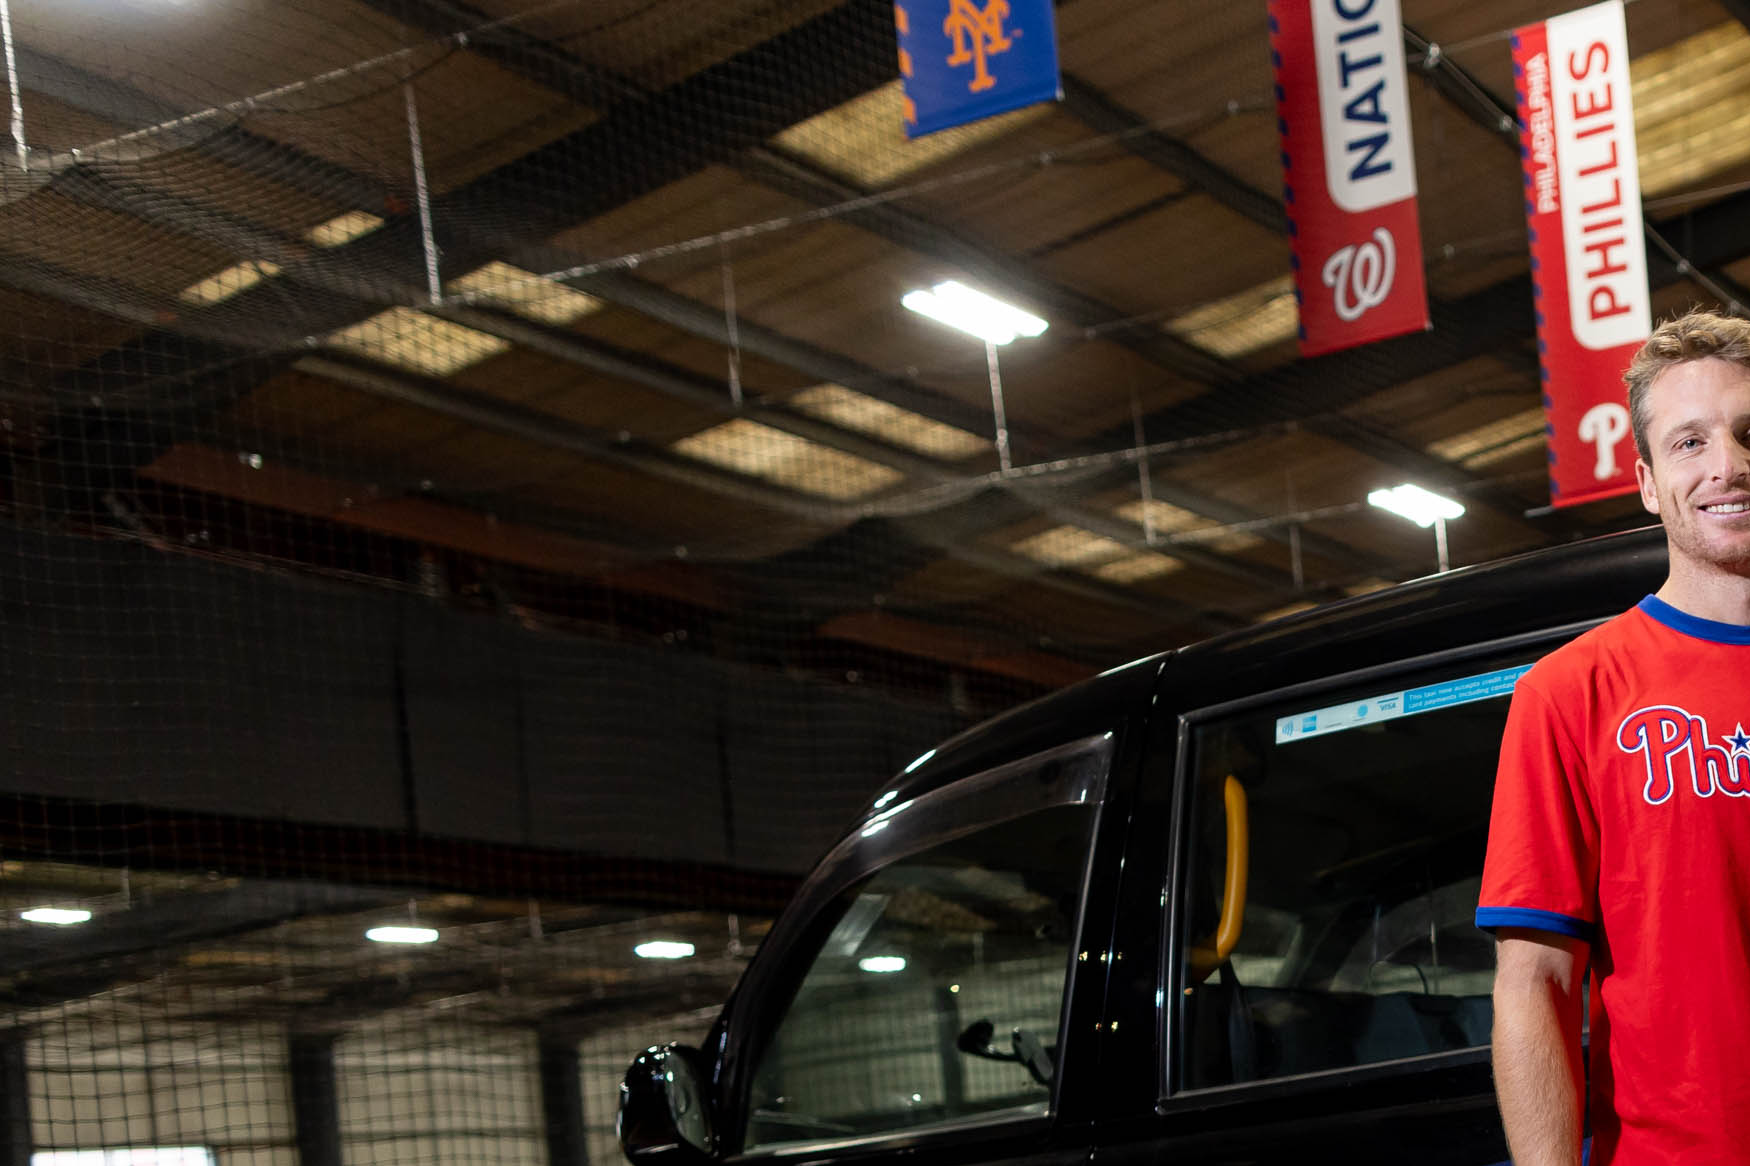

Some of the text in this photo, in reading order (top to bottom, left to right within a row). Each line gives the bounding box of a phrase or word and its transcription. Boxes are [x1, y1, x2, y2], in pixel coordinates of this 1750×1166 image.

[1537, 53, 1560, 213] PHILADELPHIA
[1570, 40, 1631, 322] PHILLIES
[1578, 402, 1631, 481] P
